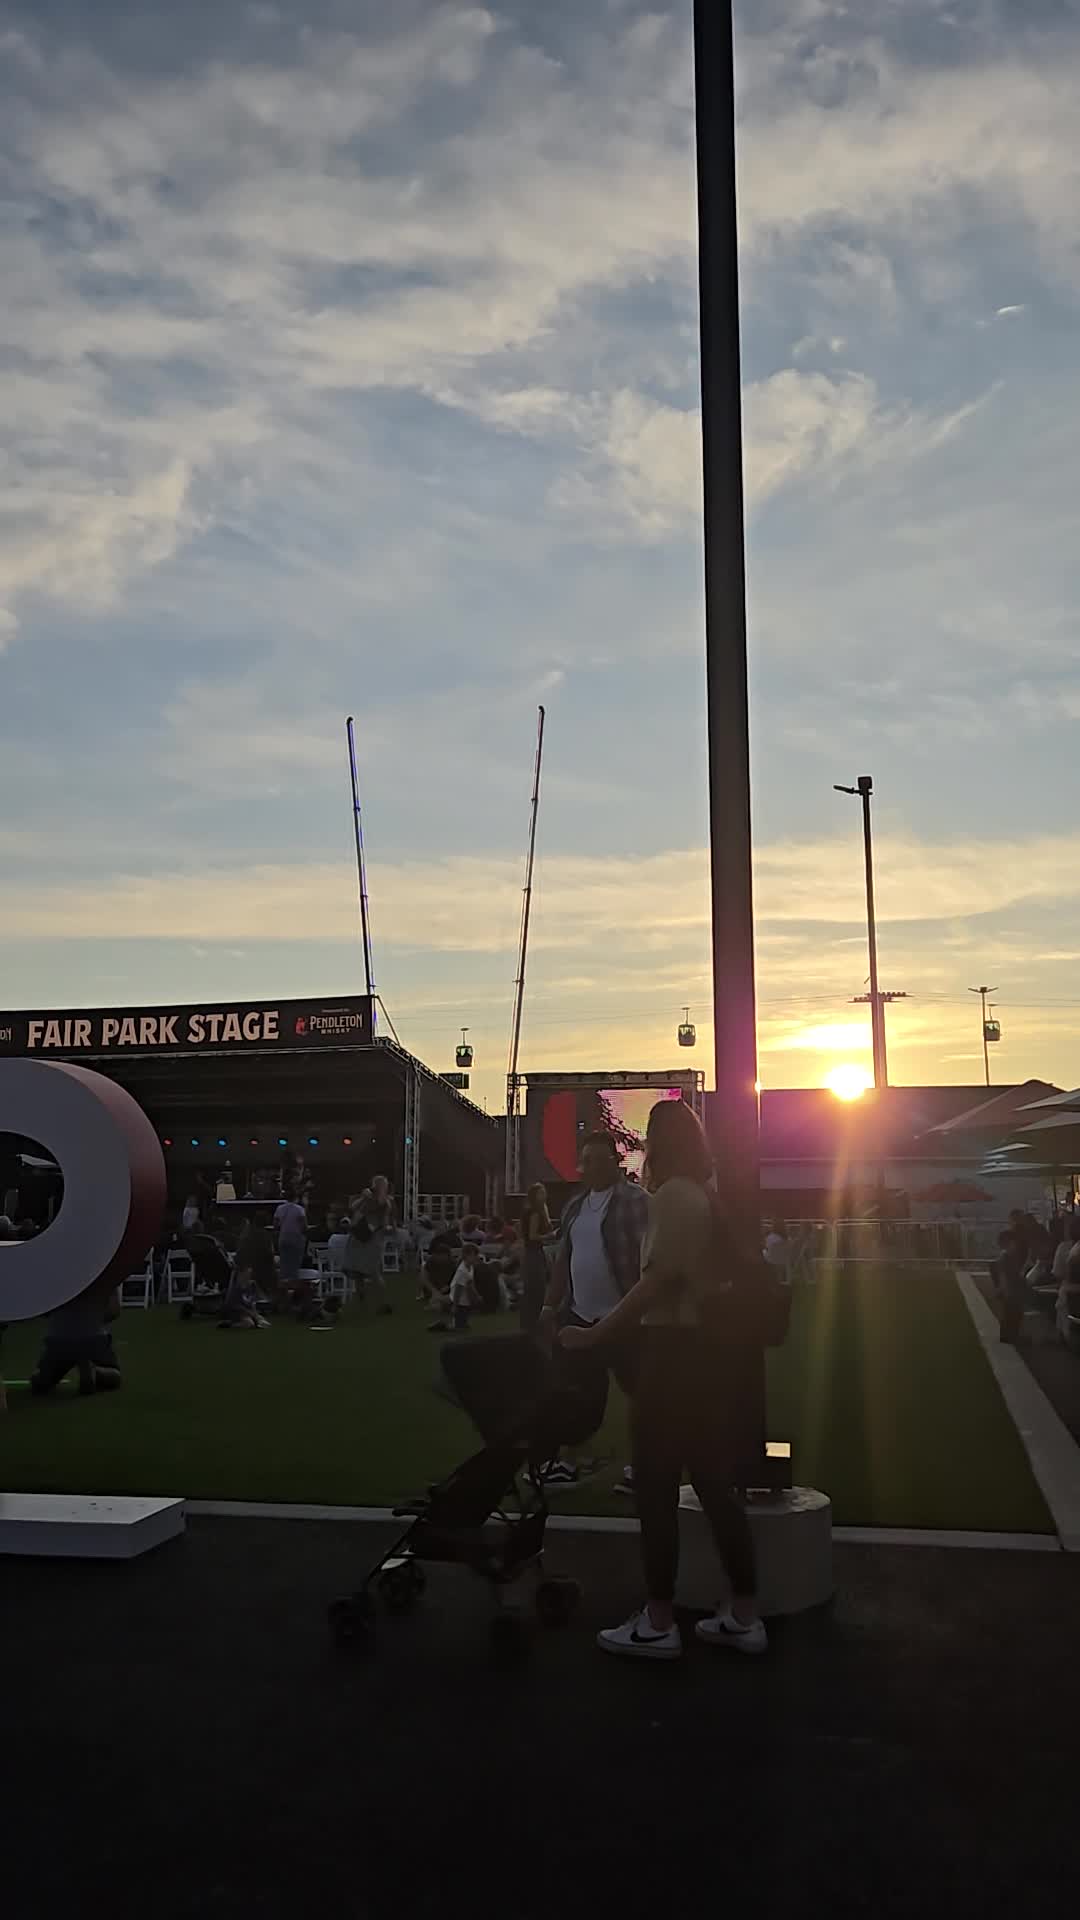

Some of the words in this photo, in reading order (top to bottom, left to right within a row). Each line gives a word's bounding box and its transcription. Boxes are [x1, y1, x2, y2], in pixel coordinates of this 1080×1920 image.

[27, 1020, 92, 1048] FAIR
[101, 1016, 180, 1046] PARK
[187, 1011, 280, 1043] STAGE
[309, 1014, 363, 1031] PENDLETON
